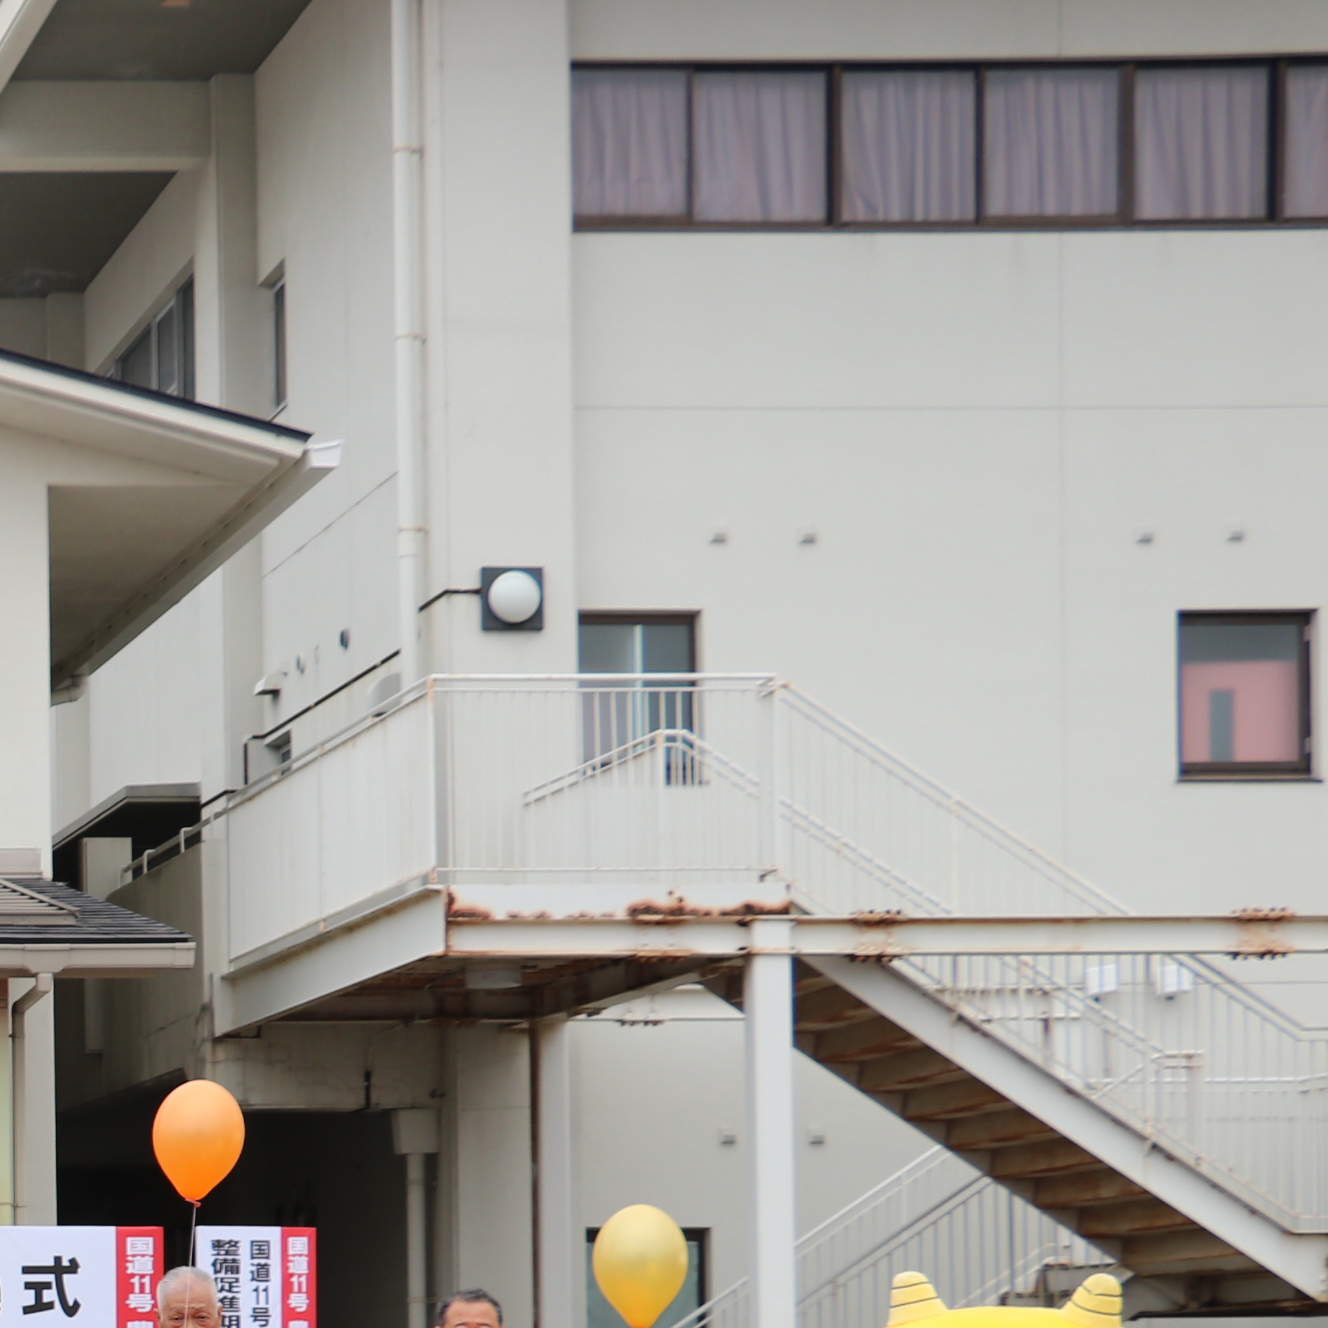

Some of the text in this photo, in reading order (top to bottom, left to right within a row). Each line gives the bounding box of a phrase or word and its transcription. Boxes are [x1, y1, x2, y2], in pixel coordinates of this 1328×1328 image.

[126, 1236, 155, 1313] 国道11号
[287, 1236, 310, 1312] 国道11号
